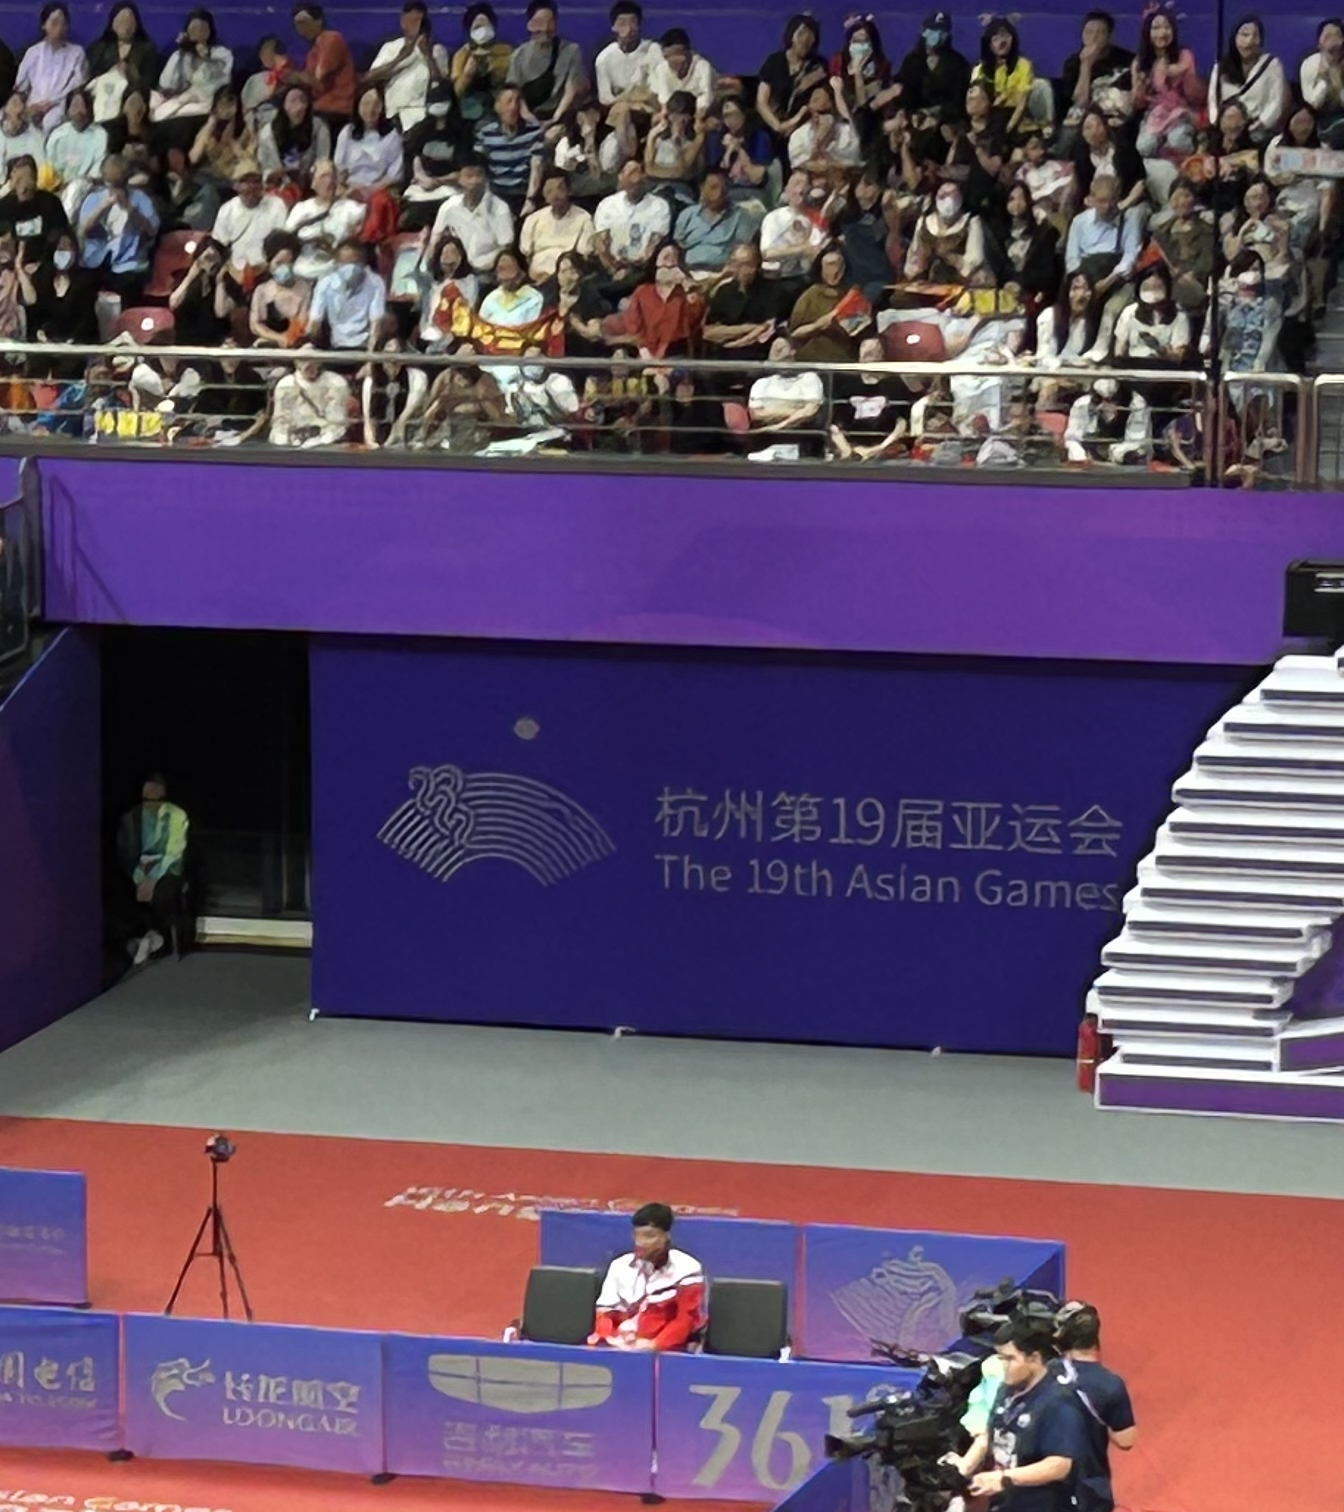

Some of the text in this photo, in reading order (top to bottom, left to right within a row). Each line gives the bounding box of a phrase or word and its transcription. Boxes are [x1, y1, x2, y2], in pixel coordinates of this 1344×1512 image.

[654, 787, 1123, 857] 杭州第19届亚运会
[654, 854, 1118, 912] The 19th Asian Games
